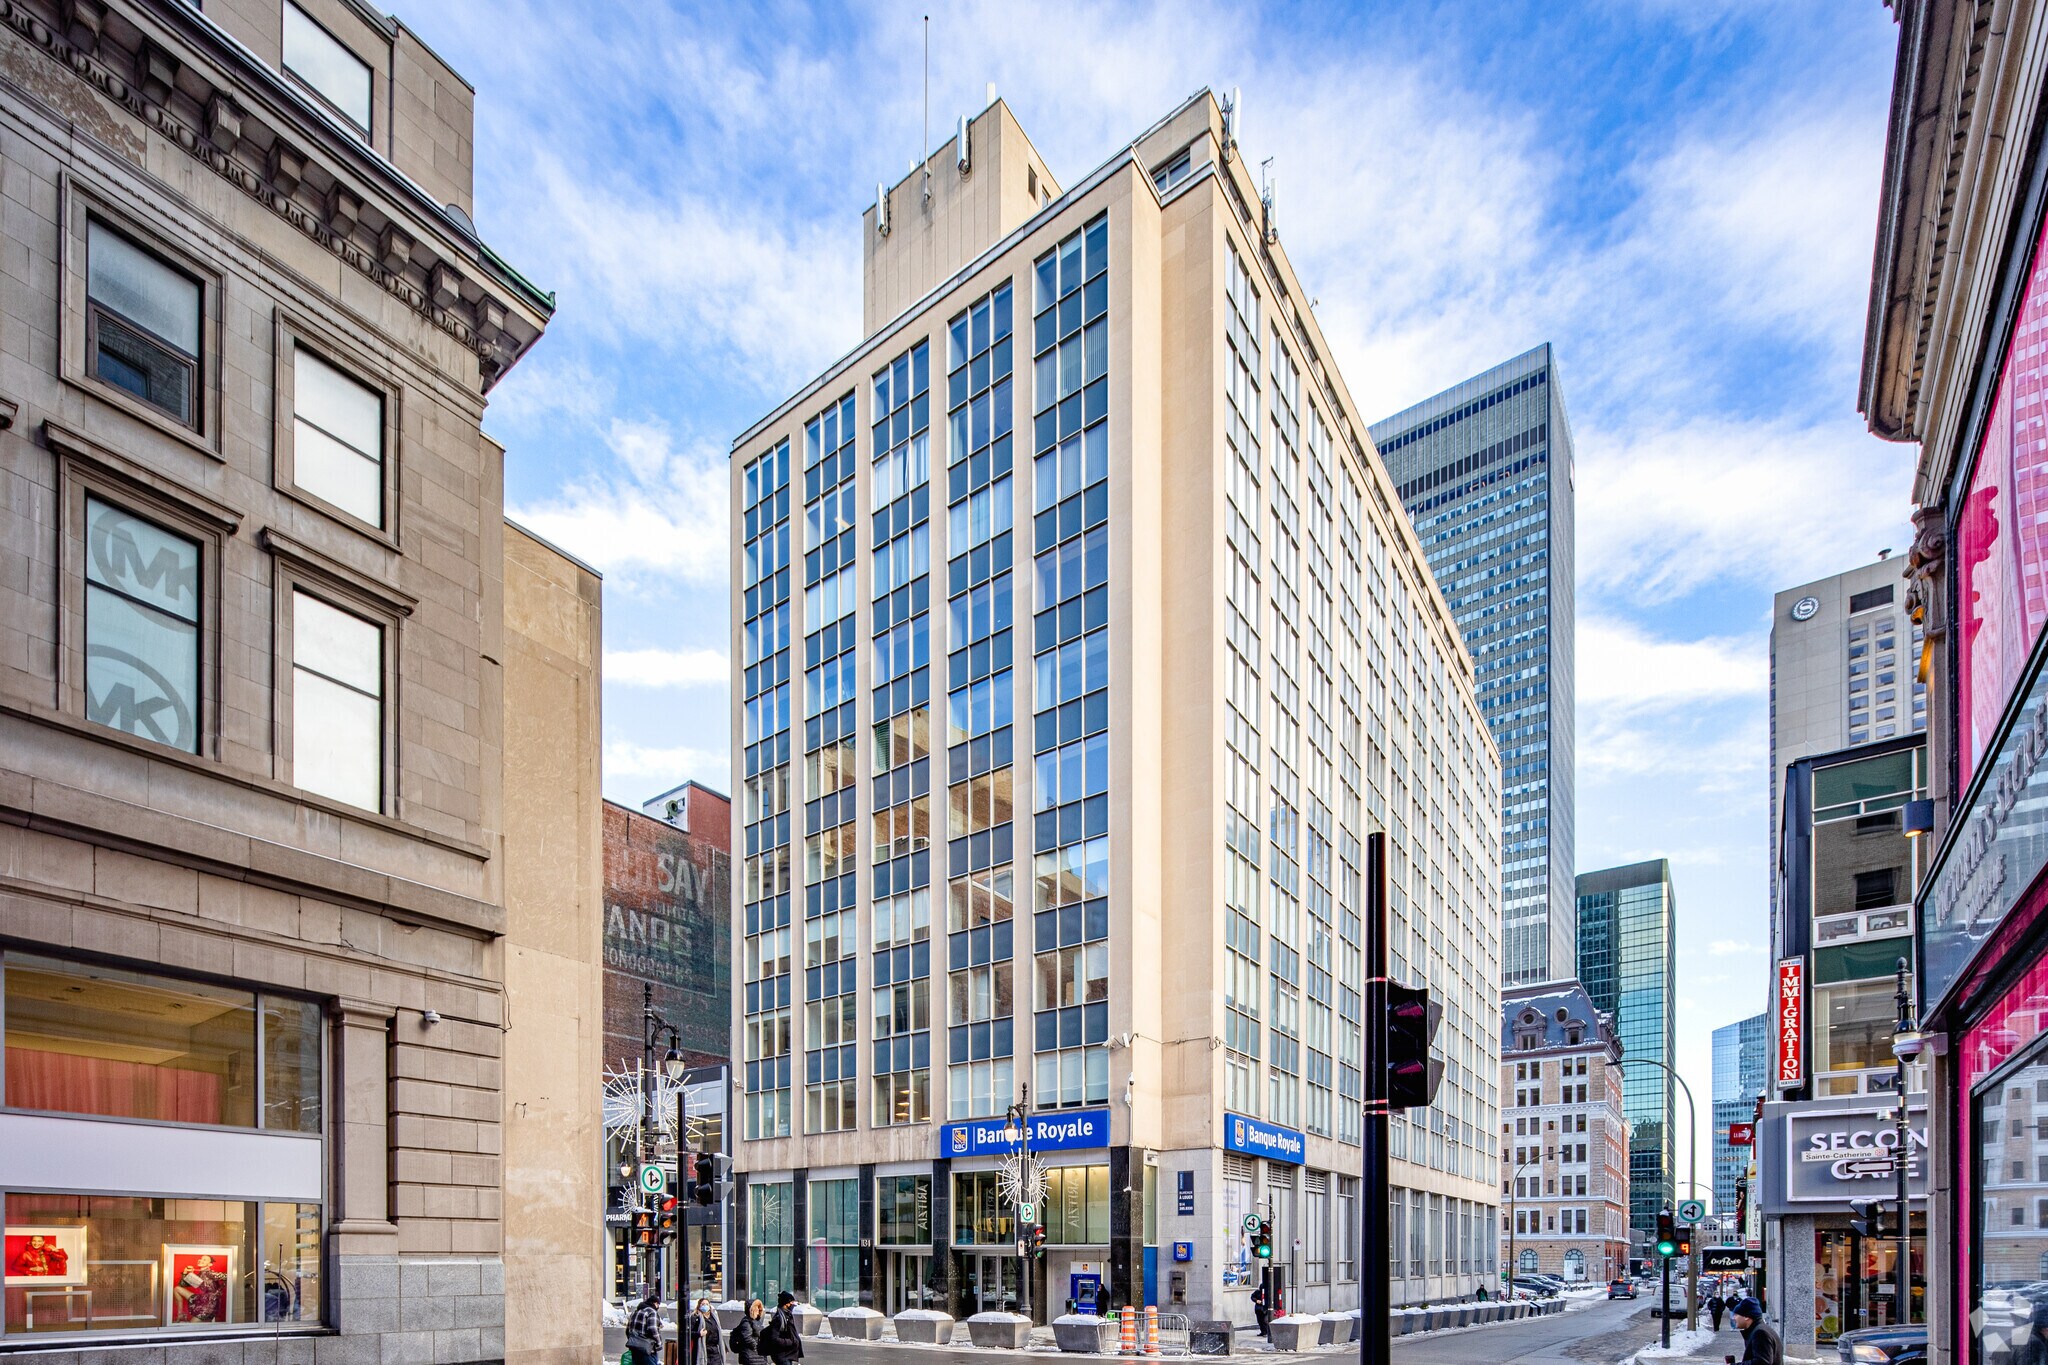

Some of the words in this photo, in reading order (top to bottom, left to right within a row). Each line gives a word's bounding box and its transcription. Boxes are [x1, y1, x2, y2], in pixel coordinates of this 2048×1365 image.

[1995, 692, 2048, 825] SECRE
[1782, 966, 1800, 1080] IMMIGRATION
[977, 1127, 1033, 1146] Banue
[1037, 1118, 1094, 1143] Royale
[1249, 1125, 1277, 1151] Banque
[1277, 1133, 1301, 1155] Royale
[1805, 1152, 1872, 1160] Sainte-Catherine
[1681, 1243, 1689, 1254] 9
